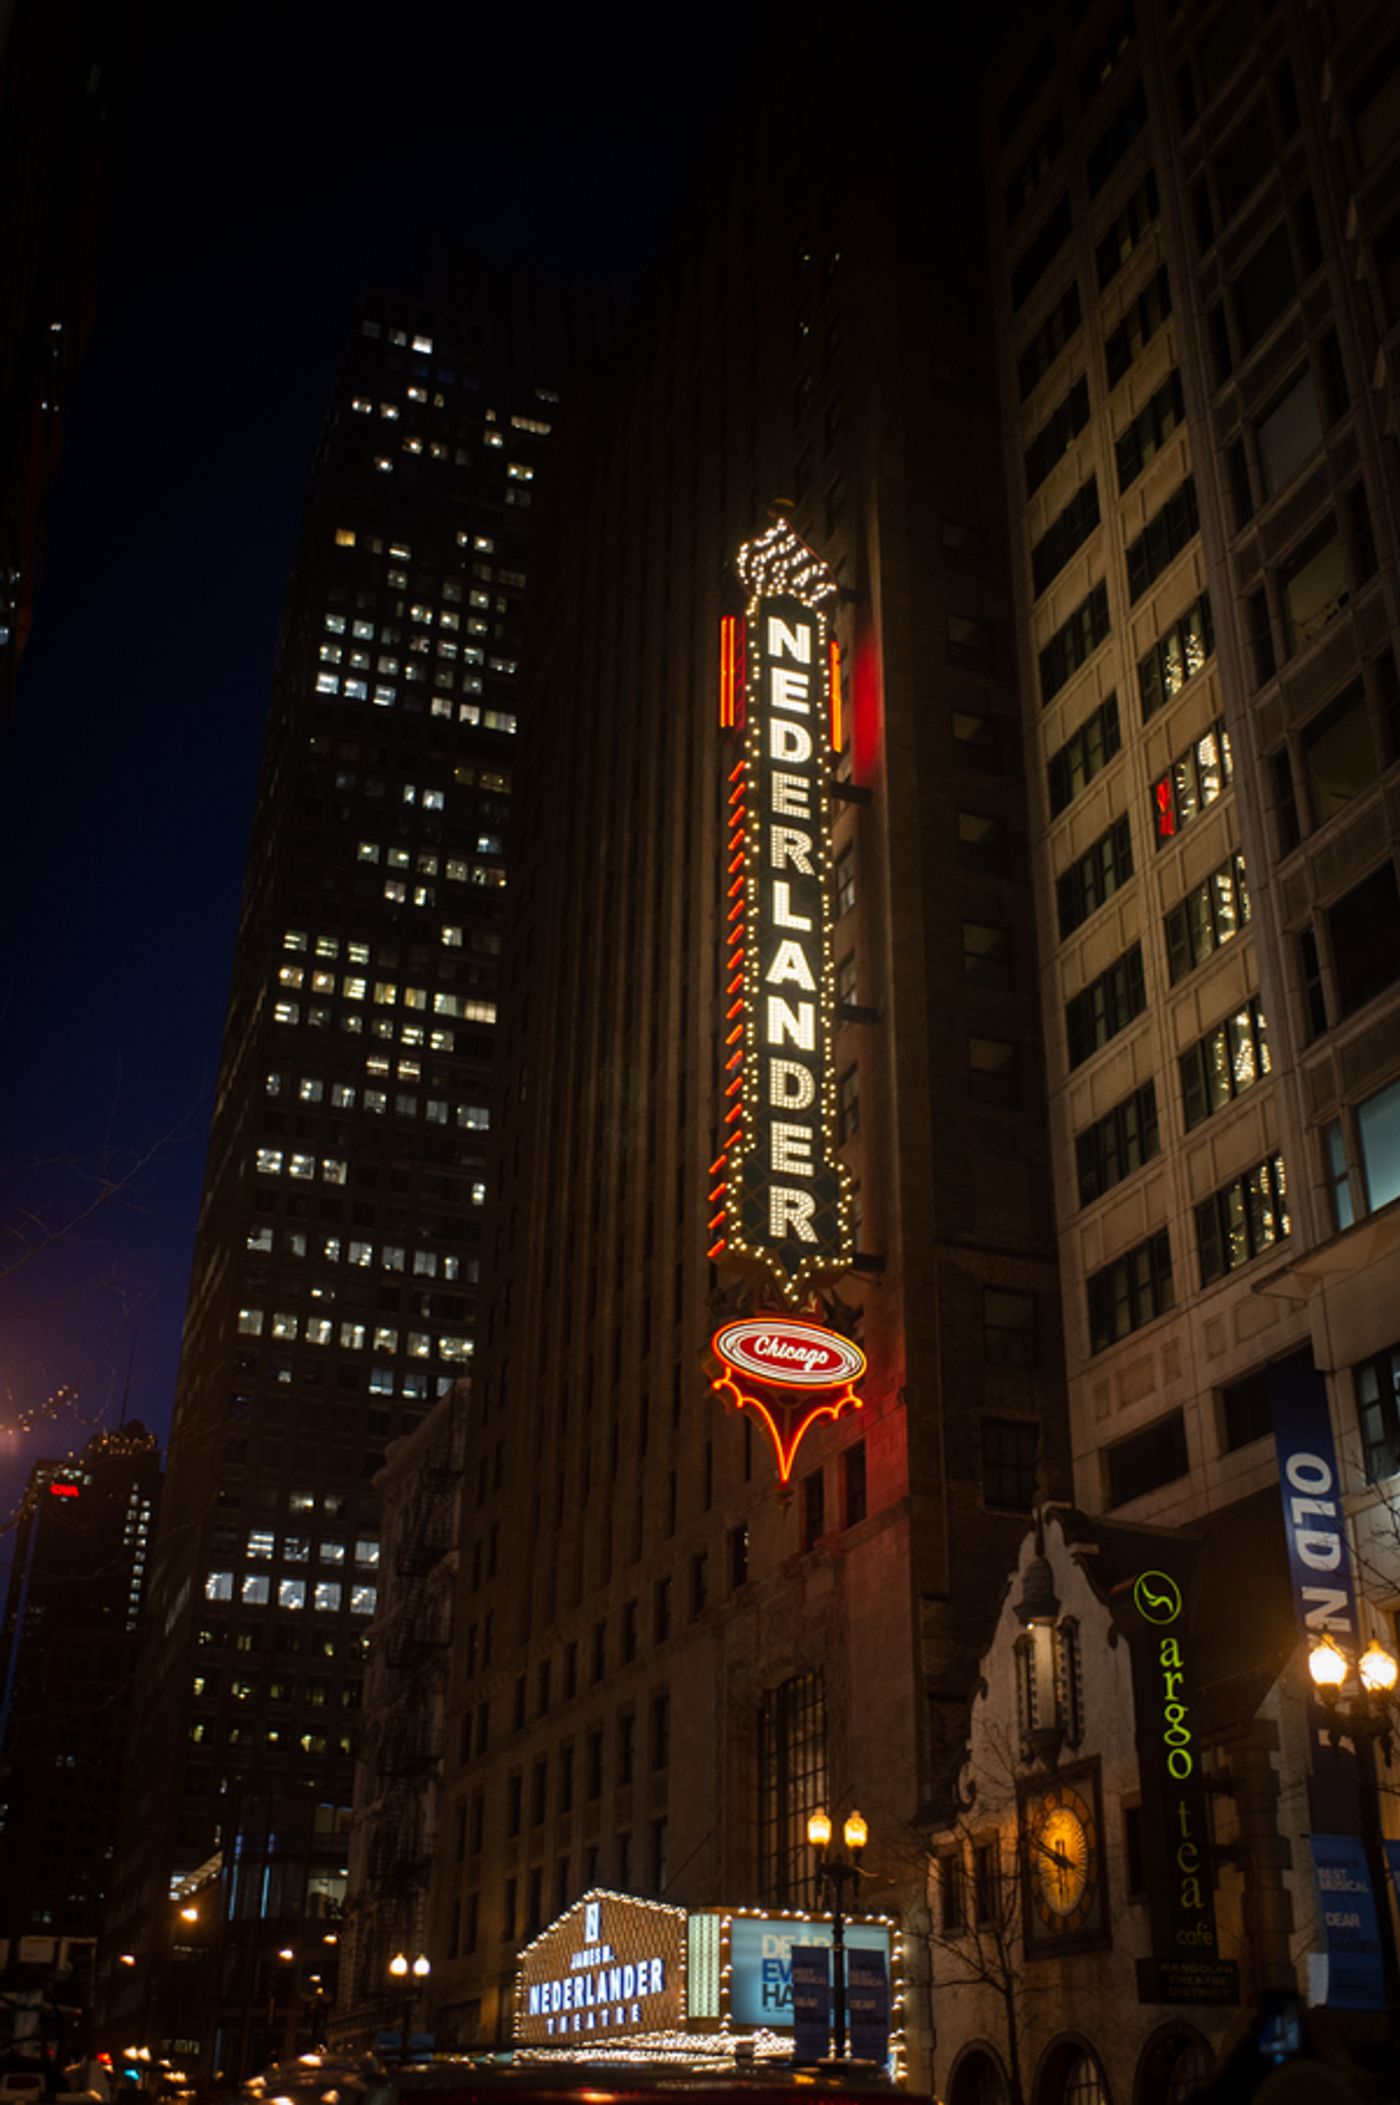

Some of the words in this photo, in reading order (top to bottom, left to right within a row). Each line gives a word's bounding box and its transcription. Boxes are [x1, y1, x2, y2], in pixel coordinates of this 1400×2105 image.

[766, 616, 819, 1244] NEDERLANDER
[754, 1336, 829, 1371] Chicago
[1285, 1452, 1343, 1572] OLD
[1159, 1636, 1194, 1780] argo
[1176, 1799, 1206, 1910] tea
[1325, 1911, 1361, 1928] DEAR
[529, 1957, 663, 2015] NEDERLANDER
[547, 2003, 640, 2035] THEATRE
